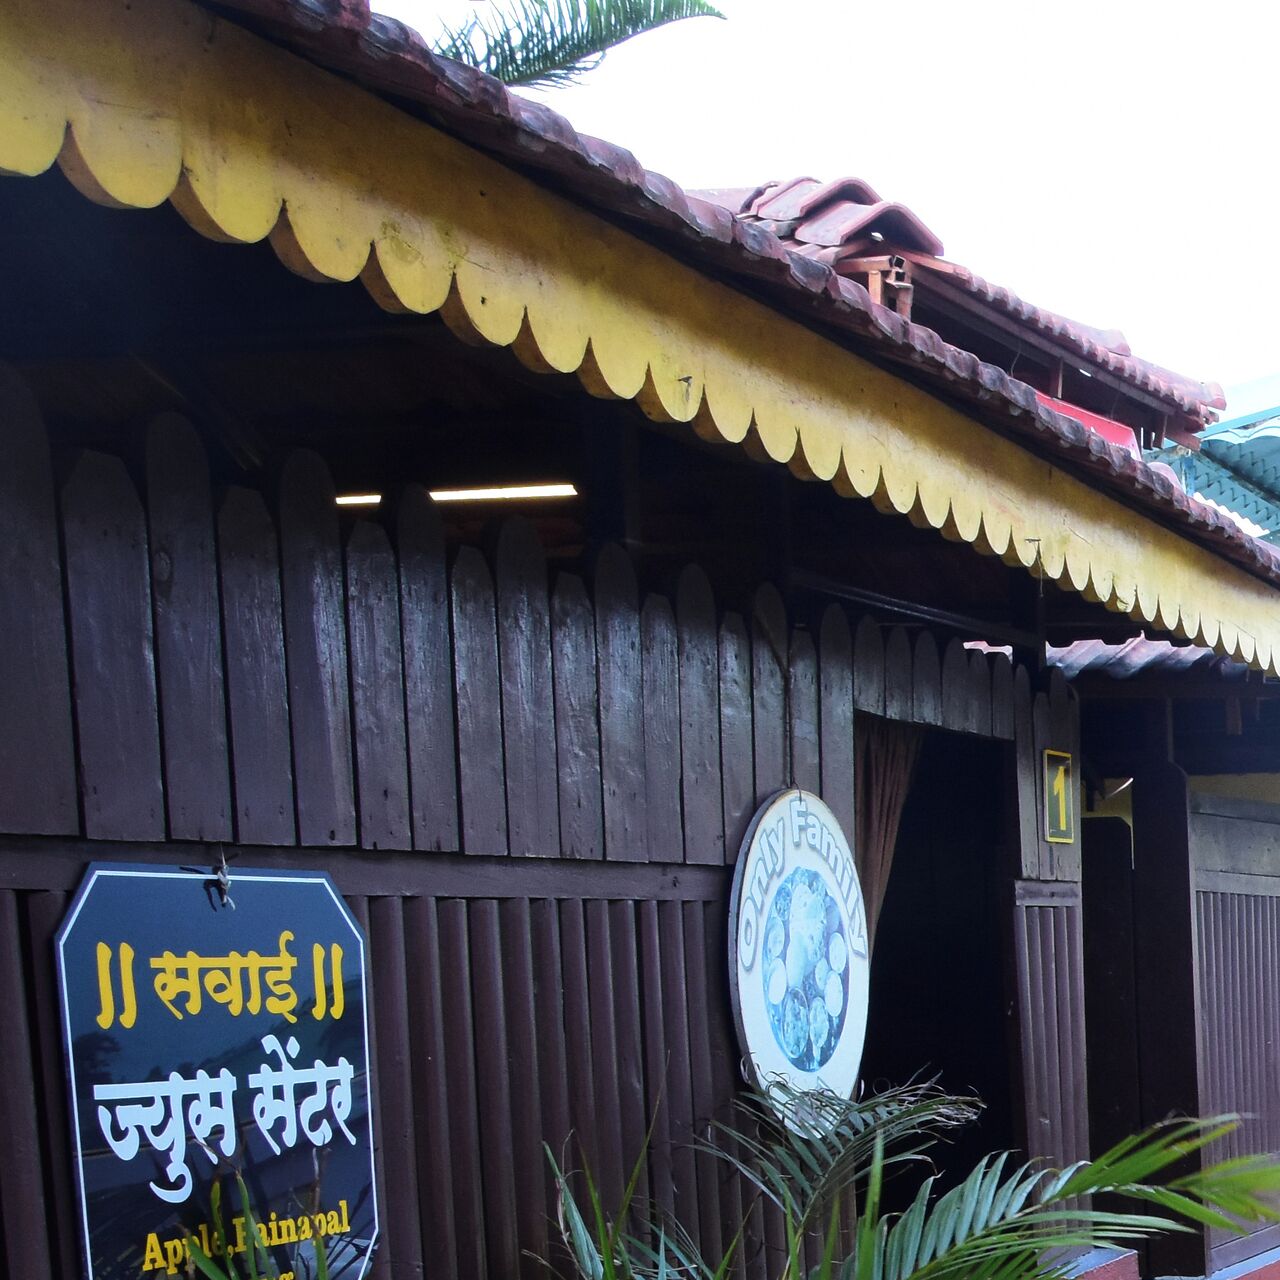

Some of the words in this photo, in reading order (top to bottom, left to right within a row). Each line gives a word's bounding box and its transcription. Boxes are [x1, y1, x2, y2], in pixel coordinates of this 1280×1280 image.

[1053, 765, 1067, 831] 1
[739, 815, 786, 971] Only
[788, 797, 869, 959] Family
[149, 930, 298, 1024] सवाई
[93, 1068, 237, 1203] ज्युस
[248, 1034, 357, 1156] सेंटर
